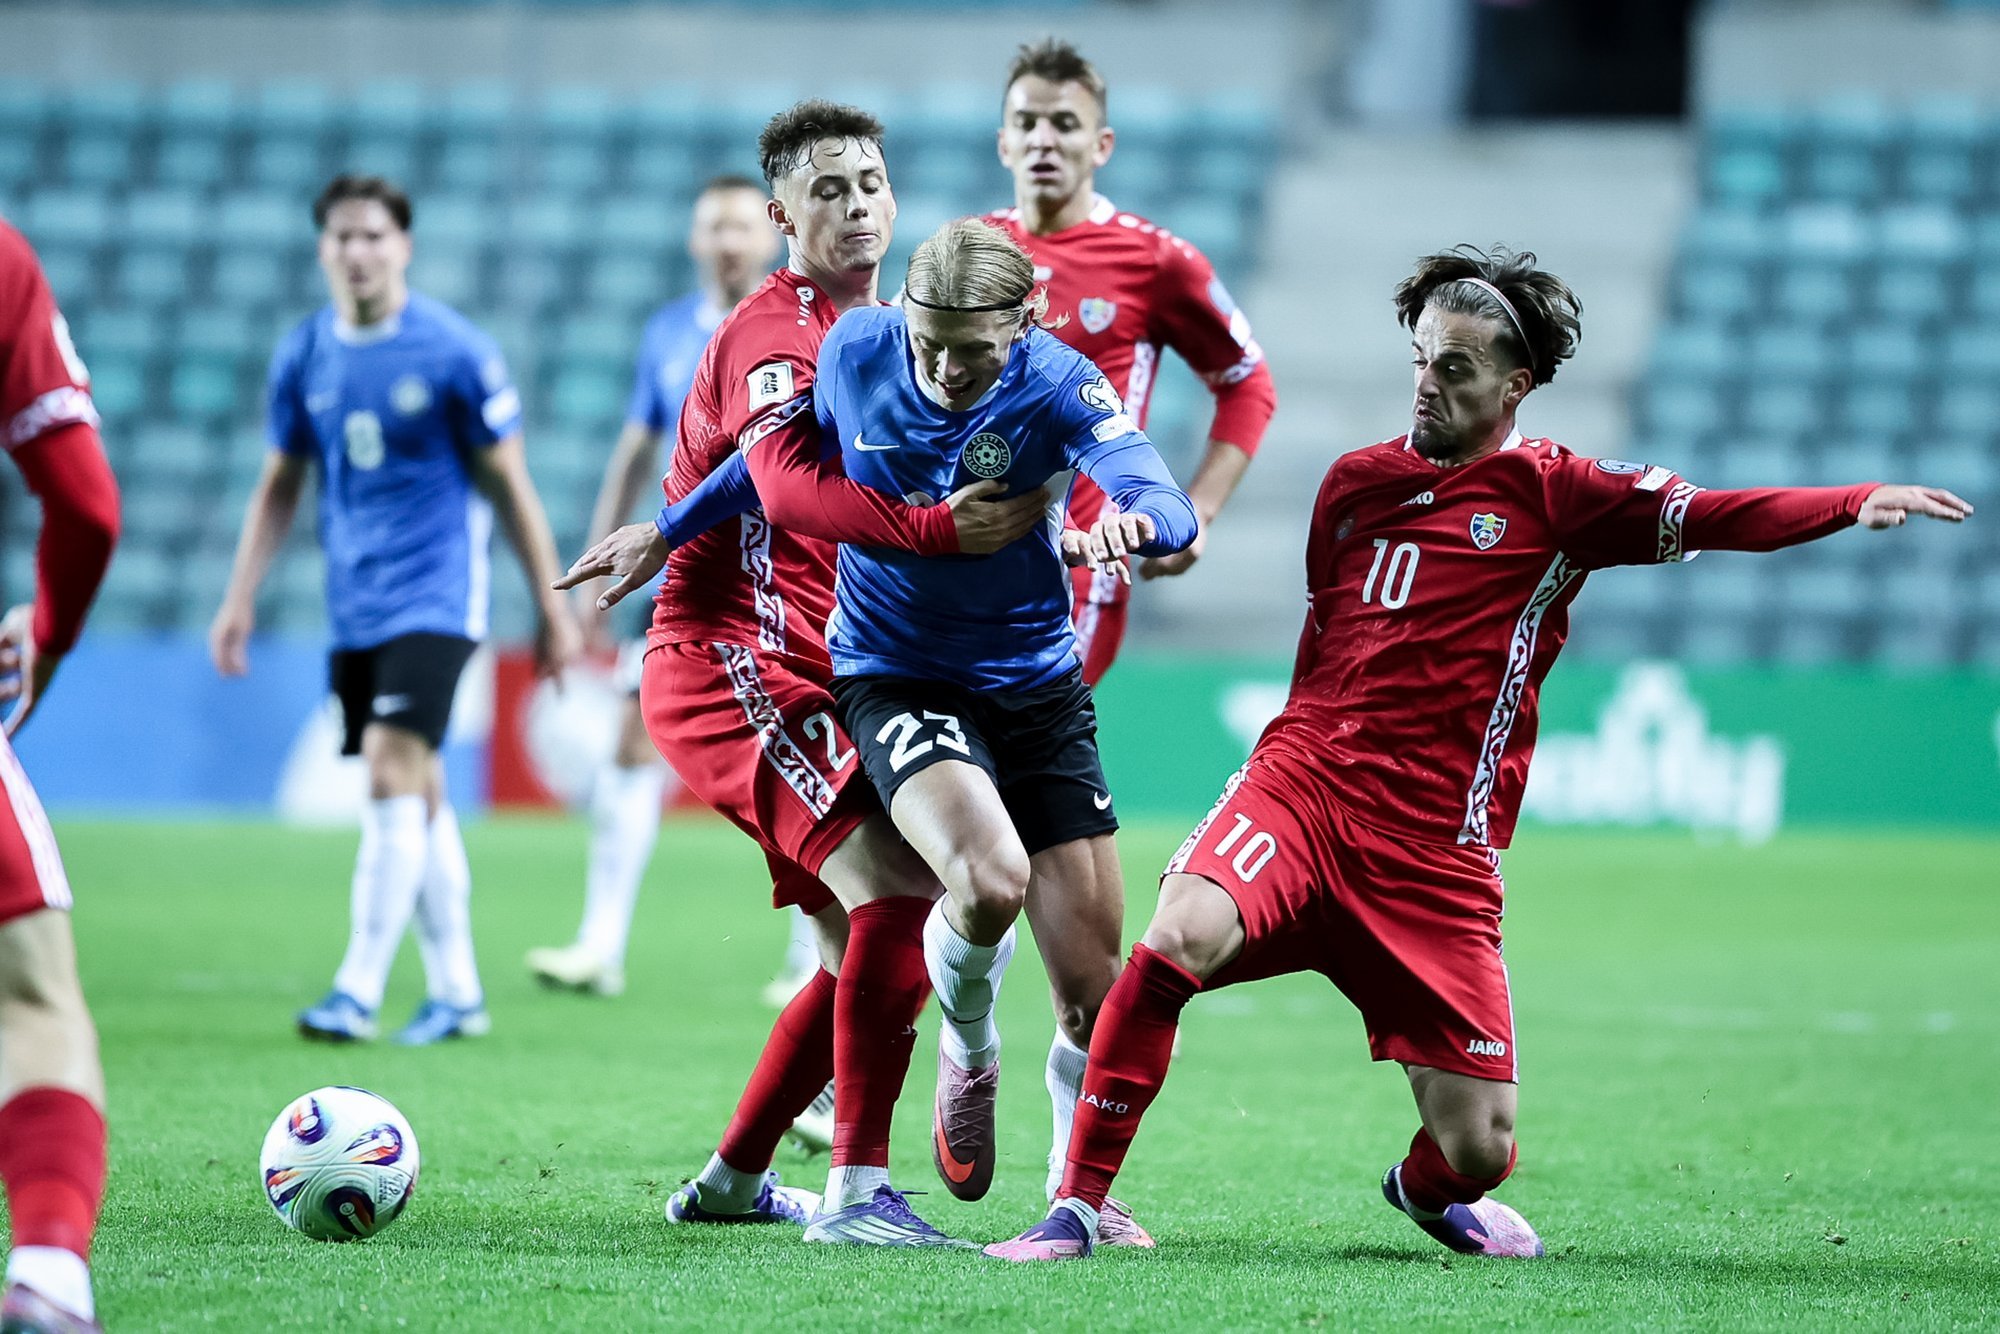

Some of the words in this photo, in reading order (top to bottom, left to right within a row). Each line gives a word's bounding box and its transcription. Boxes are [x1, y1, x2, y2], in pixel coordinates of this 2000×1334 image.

[971, 435, 998, 446] EESTI
[1363, 538, 1420, 609] 10
[803, 711, 856, 772] 2
[875, 709, 971, 773] 23
[1213, 812, 1277, 883] 10
[1466, 1040, 1506, 1057] JAKO
